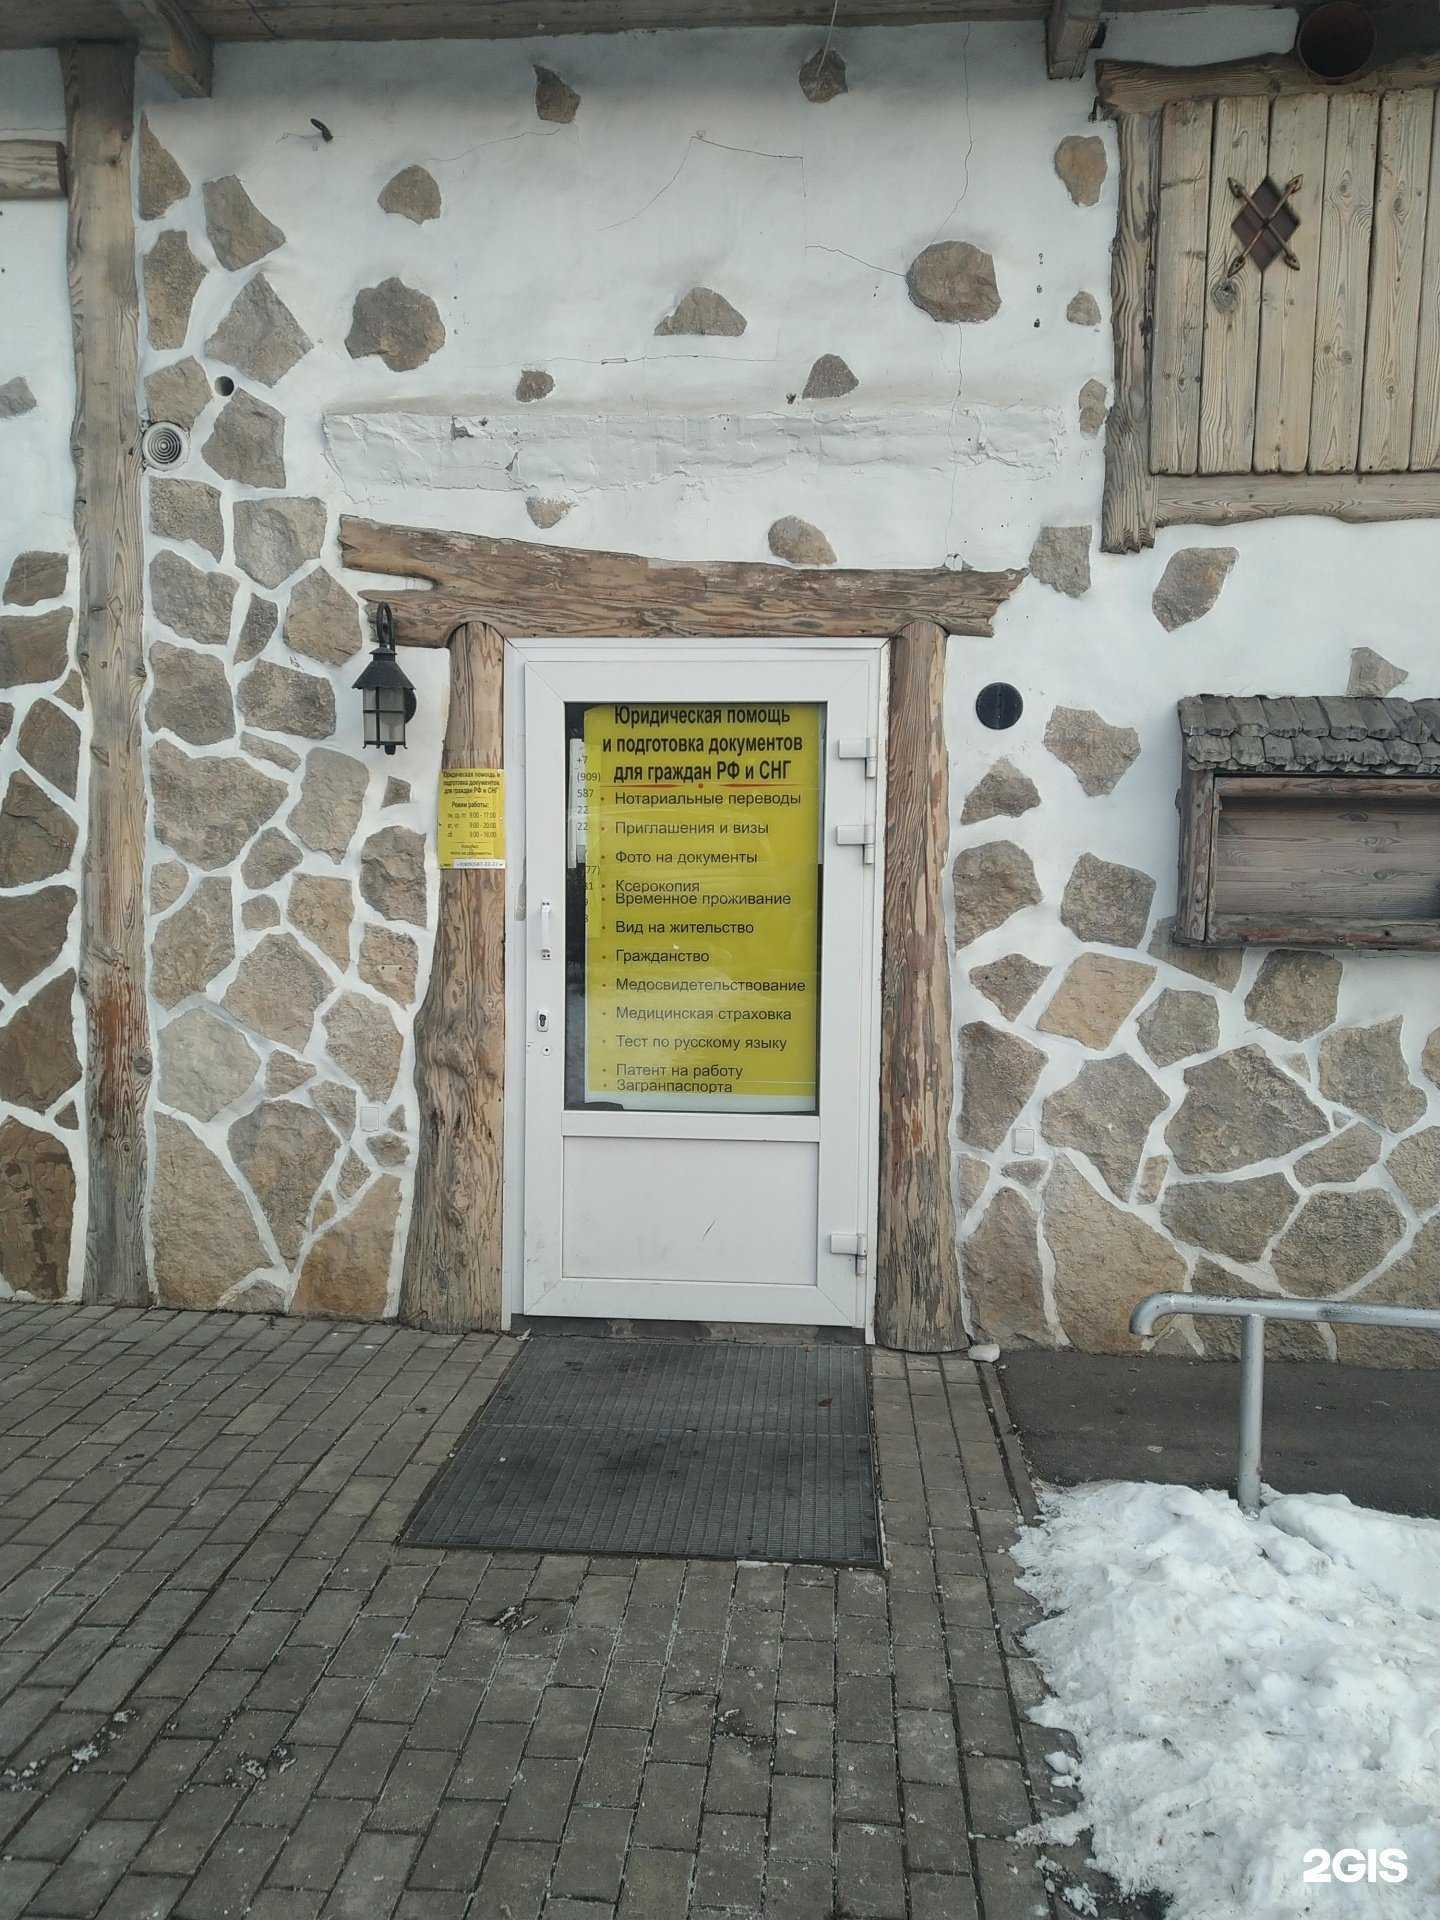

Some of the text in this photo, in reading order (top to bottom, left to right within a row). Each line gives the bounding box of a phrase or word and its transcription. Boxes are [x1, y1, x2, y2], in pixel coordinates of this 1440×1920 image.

[614, 705, 790, 727] Юридическая помощь
[603, 736, 802, 755] и подготовка документов
[613, 761, 791, 783] для граждан РФ и СНГ
[615, 792, 801, 807] Нотариальные переводы
[615, 822, 768, 835] Приглашения и визы
[615, 851, 757, 865] Фото на документы
[615, 881, 700, 893] Ксерокопия
[615, 893, 791, 907] Временное проживание
[615, 922, 754, 935] Вид на жительство
[615, 950, 709, 963] Гражданство
[615, 978, 806, 992] Медосвидетельствование
[616, 1007, 792, 1021] Медицинская страховка
[616, 1035, 787, 1052] Тест по русскому языку
[616, 1064, 743, 1079] Патент на работу
[617, 1079, 733, 1094] Загранпаспорта
